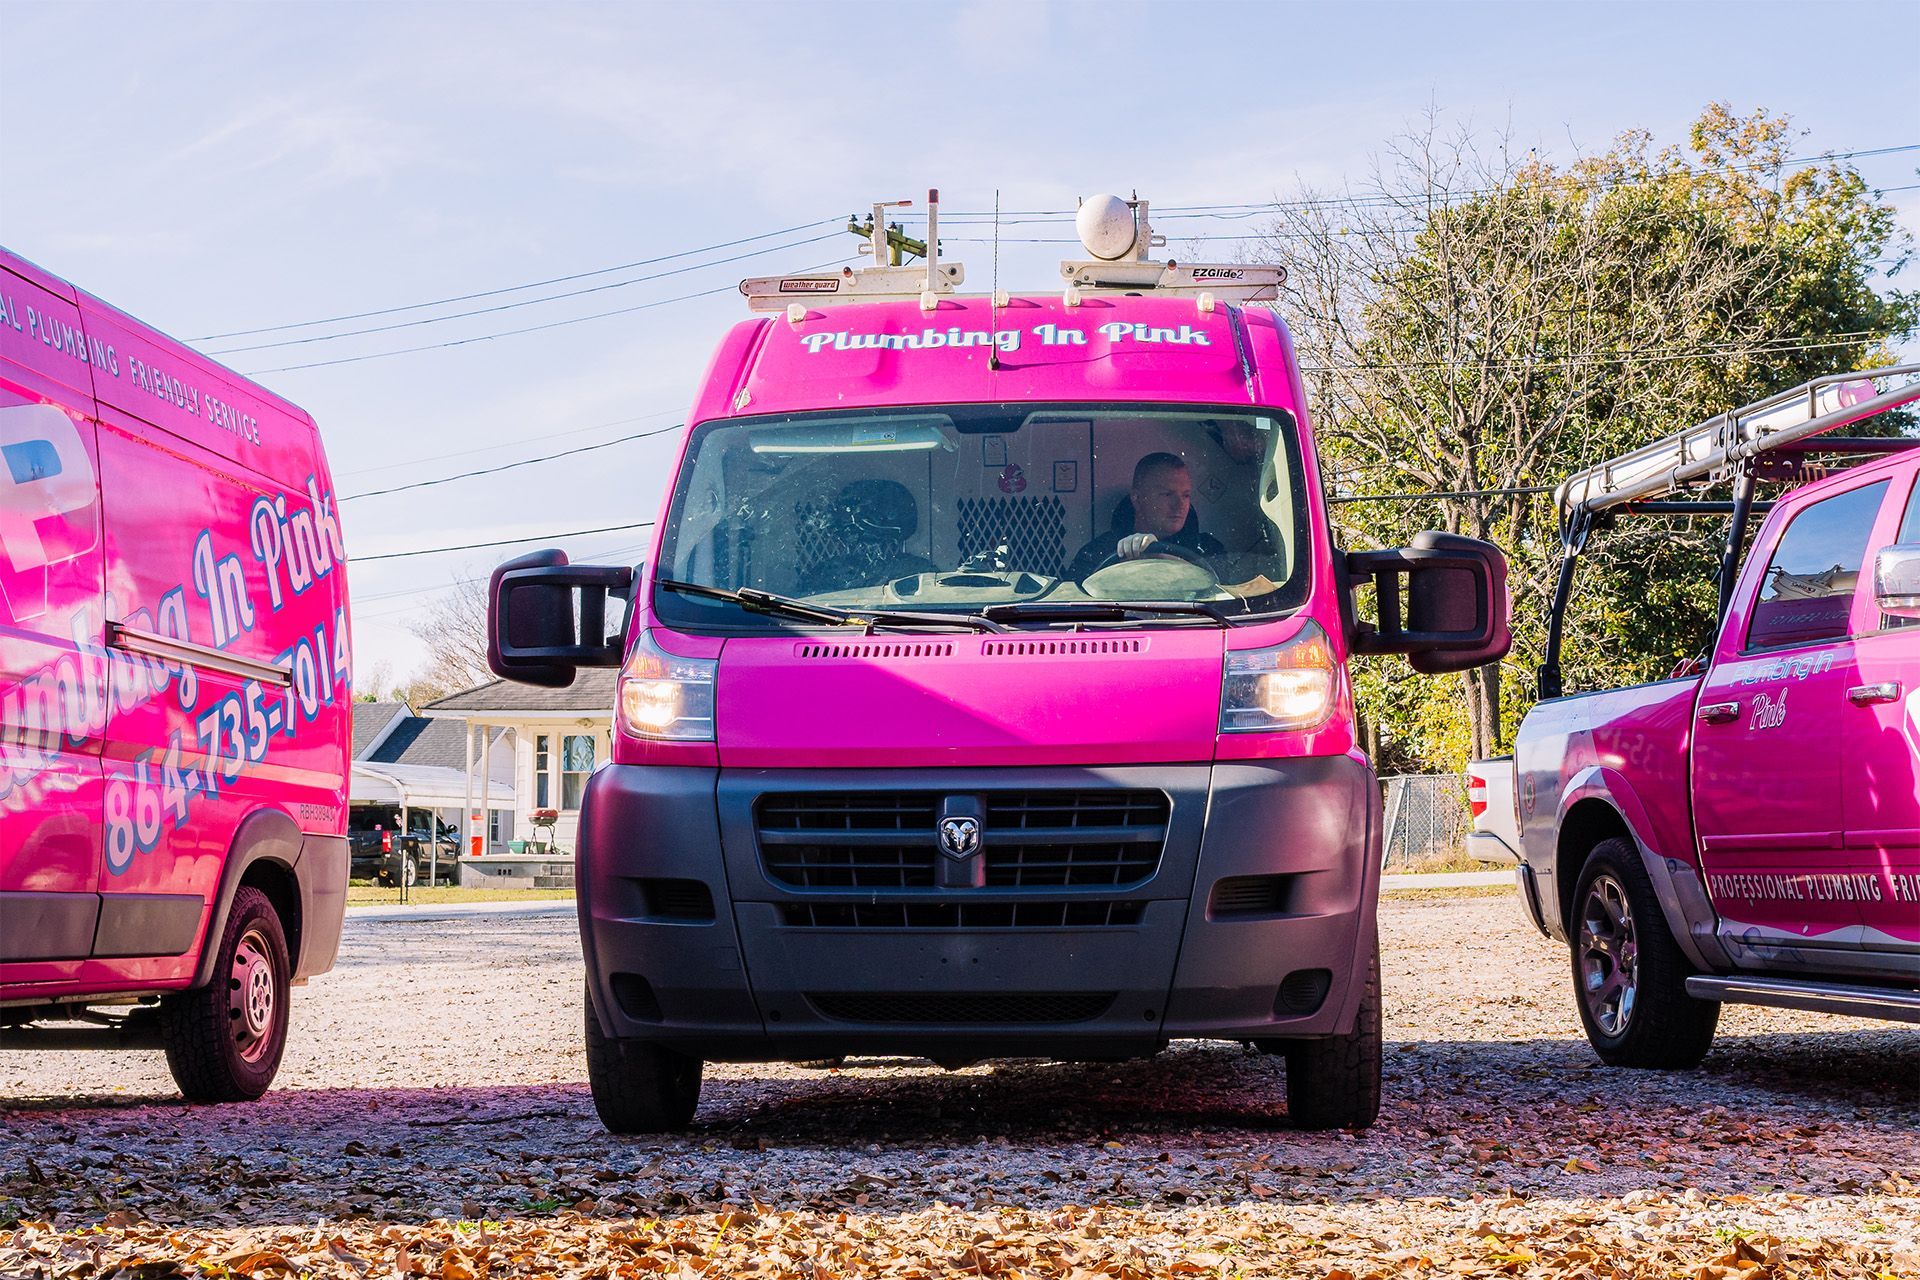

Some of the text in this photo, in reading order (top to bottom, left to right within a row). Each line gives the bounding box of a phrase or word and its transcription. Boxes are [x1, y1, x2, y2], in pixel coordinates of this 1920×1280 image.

[783, 281, 837, 290] weather guard
[801, 322, 1212, 353] Plumbing In Pink
[26, 305, 119, 377] PLUMBING
[128, 356, 201, 417] FRIENDLY
[204, 394, 261, 447] SERVICE
[192, 527, 255, 649] In
[251, 473, 345, 613] Pink
[1730, 656, 1814, 688] Plumbing
[1749, 687, 1788, 731] Pink
[105, 607, 352, 876] 864-735-7014
[1711, 874, 1804, 900] PROFESSIONAL
[1805, 873, 1882, 902] PLUMBING
